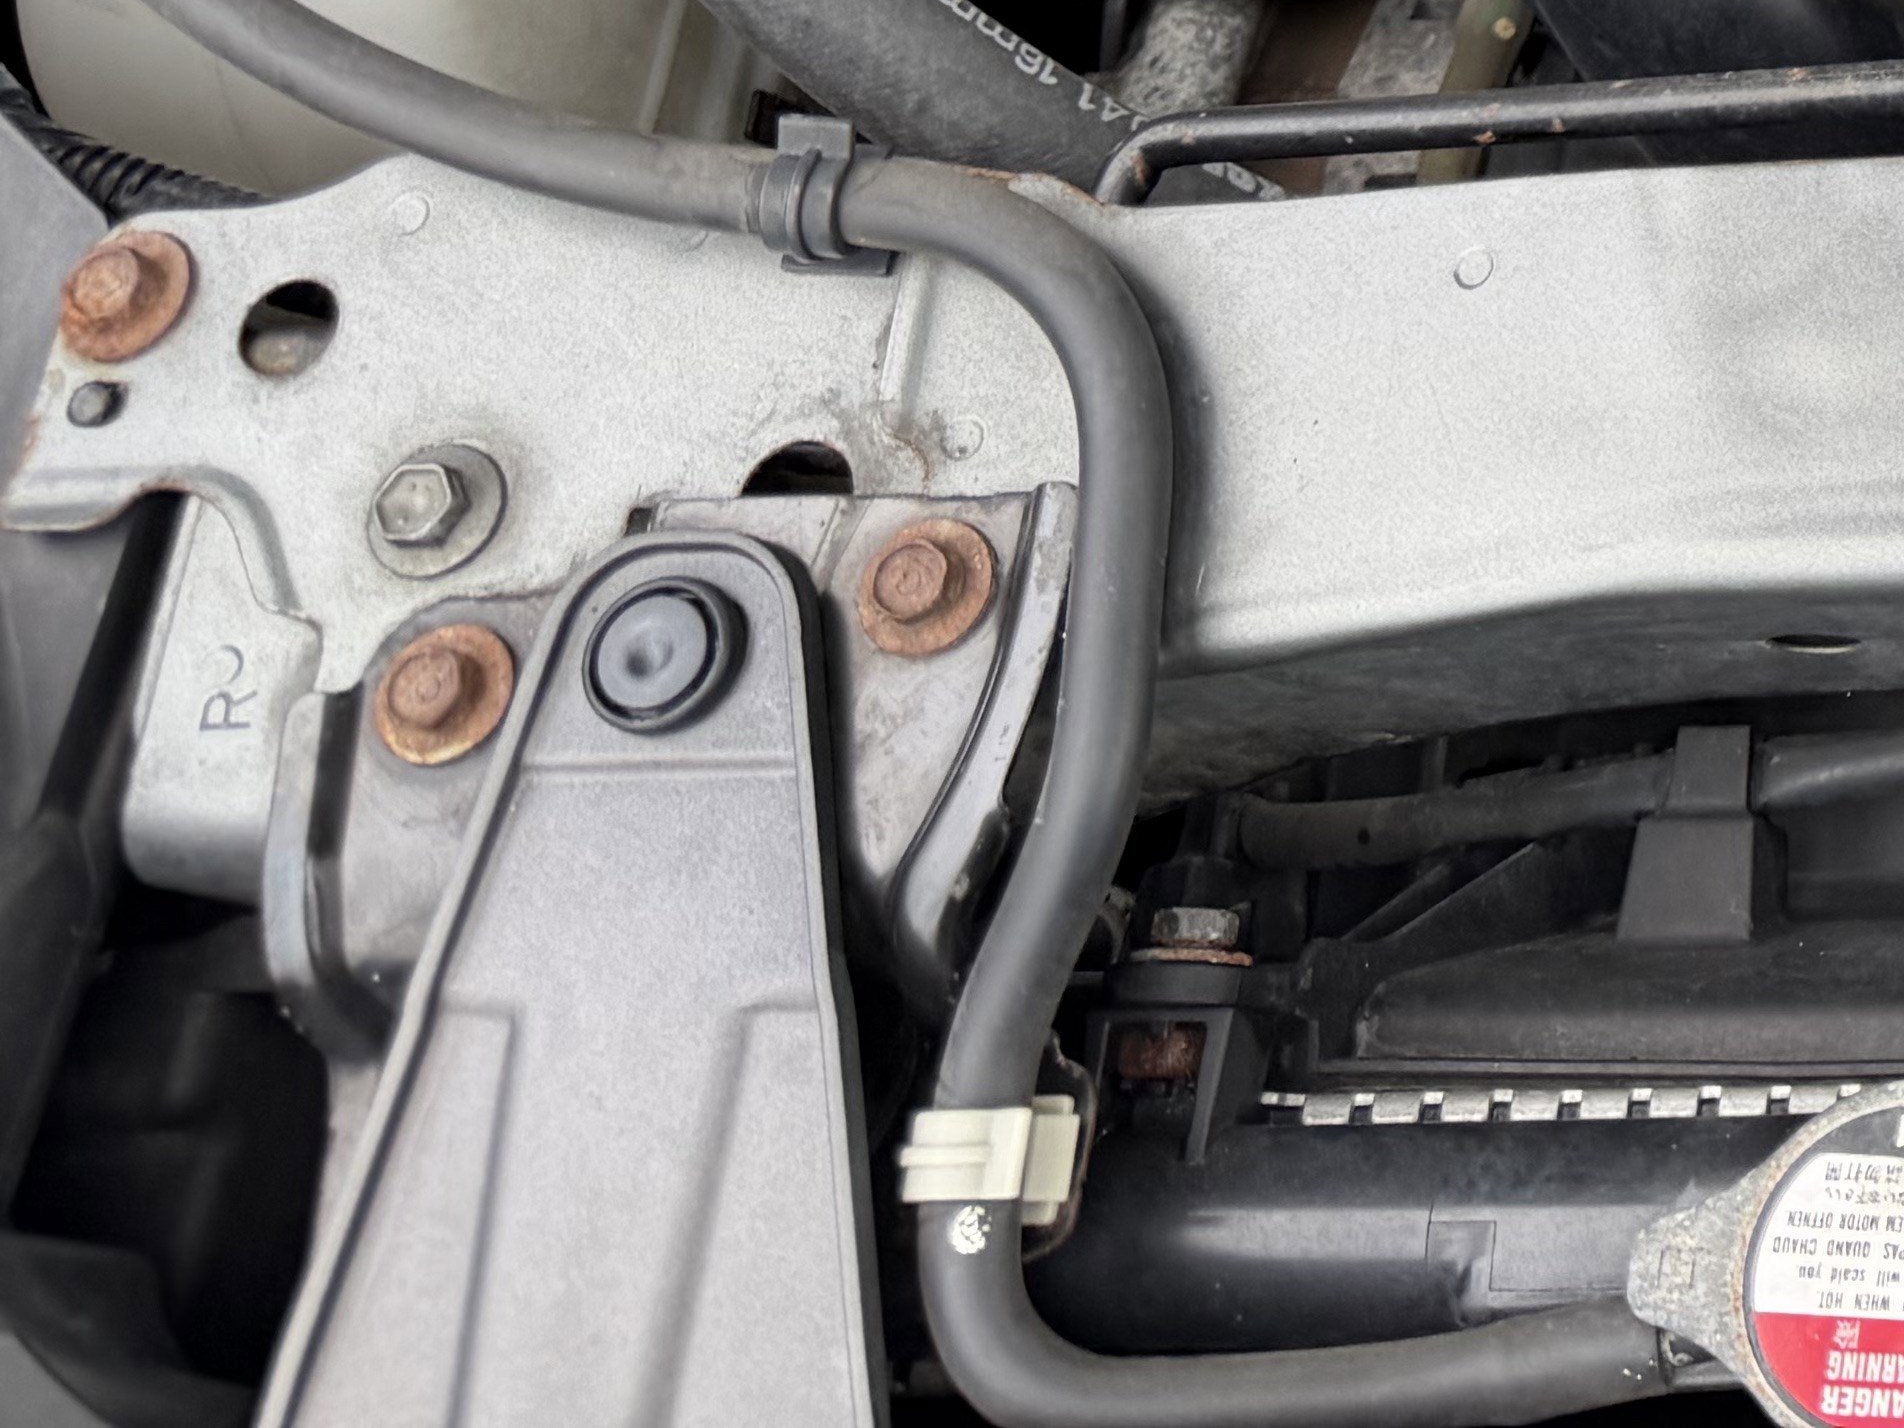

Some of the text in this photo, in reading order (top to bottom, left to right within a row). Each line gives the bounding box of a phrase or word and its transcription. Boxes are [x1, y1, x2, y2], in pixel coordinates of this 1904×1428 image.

[1839, 1212, 1880, 1231] MOTOR
[1772, 1236, 1818, 1256] CHAUD
[1827, 1239, 1871, 1259] QUAND
[1830, 1268, 1867, 1286] scald
[1876, 1270, 1900, 1287] will
[1855, 1293, 1890, 1312] WHEN
